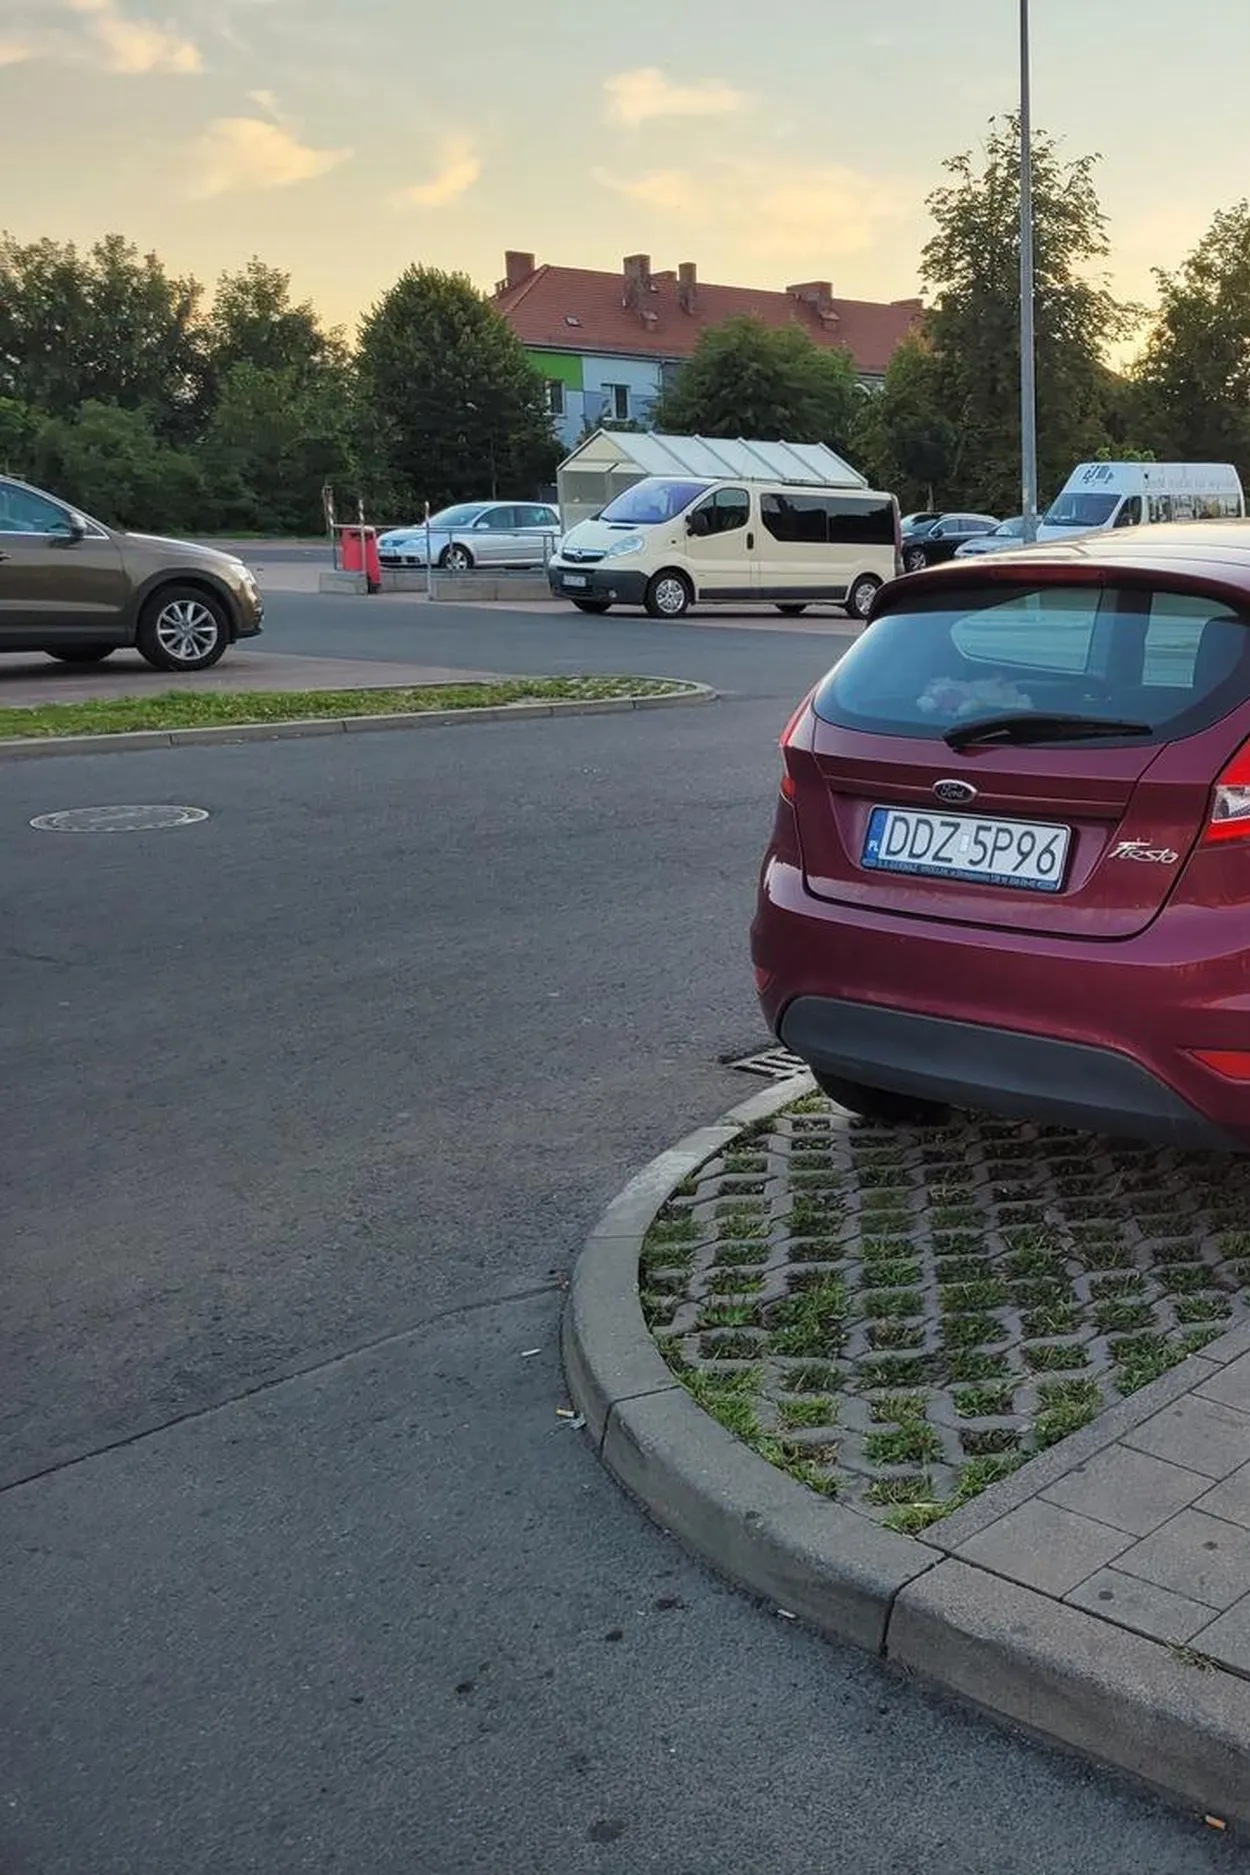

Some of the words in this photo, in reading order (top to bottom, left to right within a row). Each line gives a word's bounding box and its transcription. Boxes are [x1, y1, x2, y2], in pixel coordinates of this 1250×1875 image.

[885, 815, 961, 863] DDZ
[967, 825, 1060, 875] 5P96
[1107, 838, 1179, 864] Fiesta
